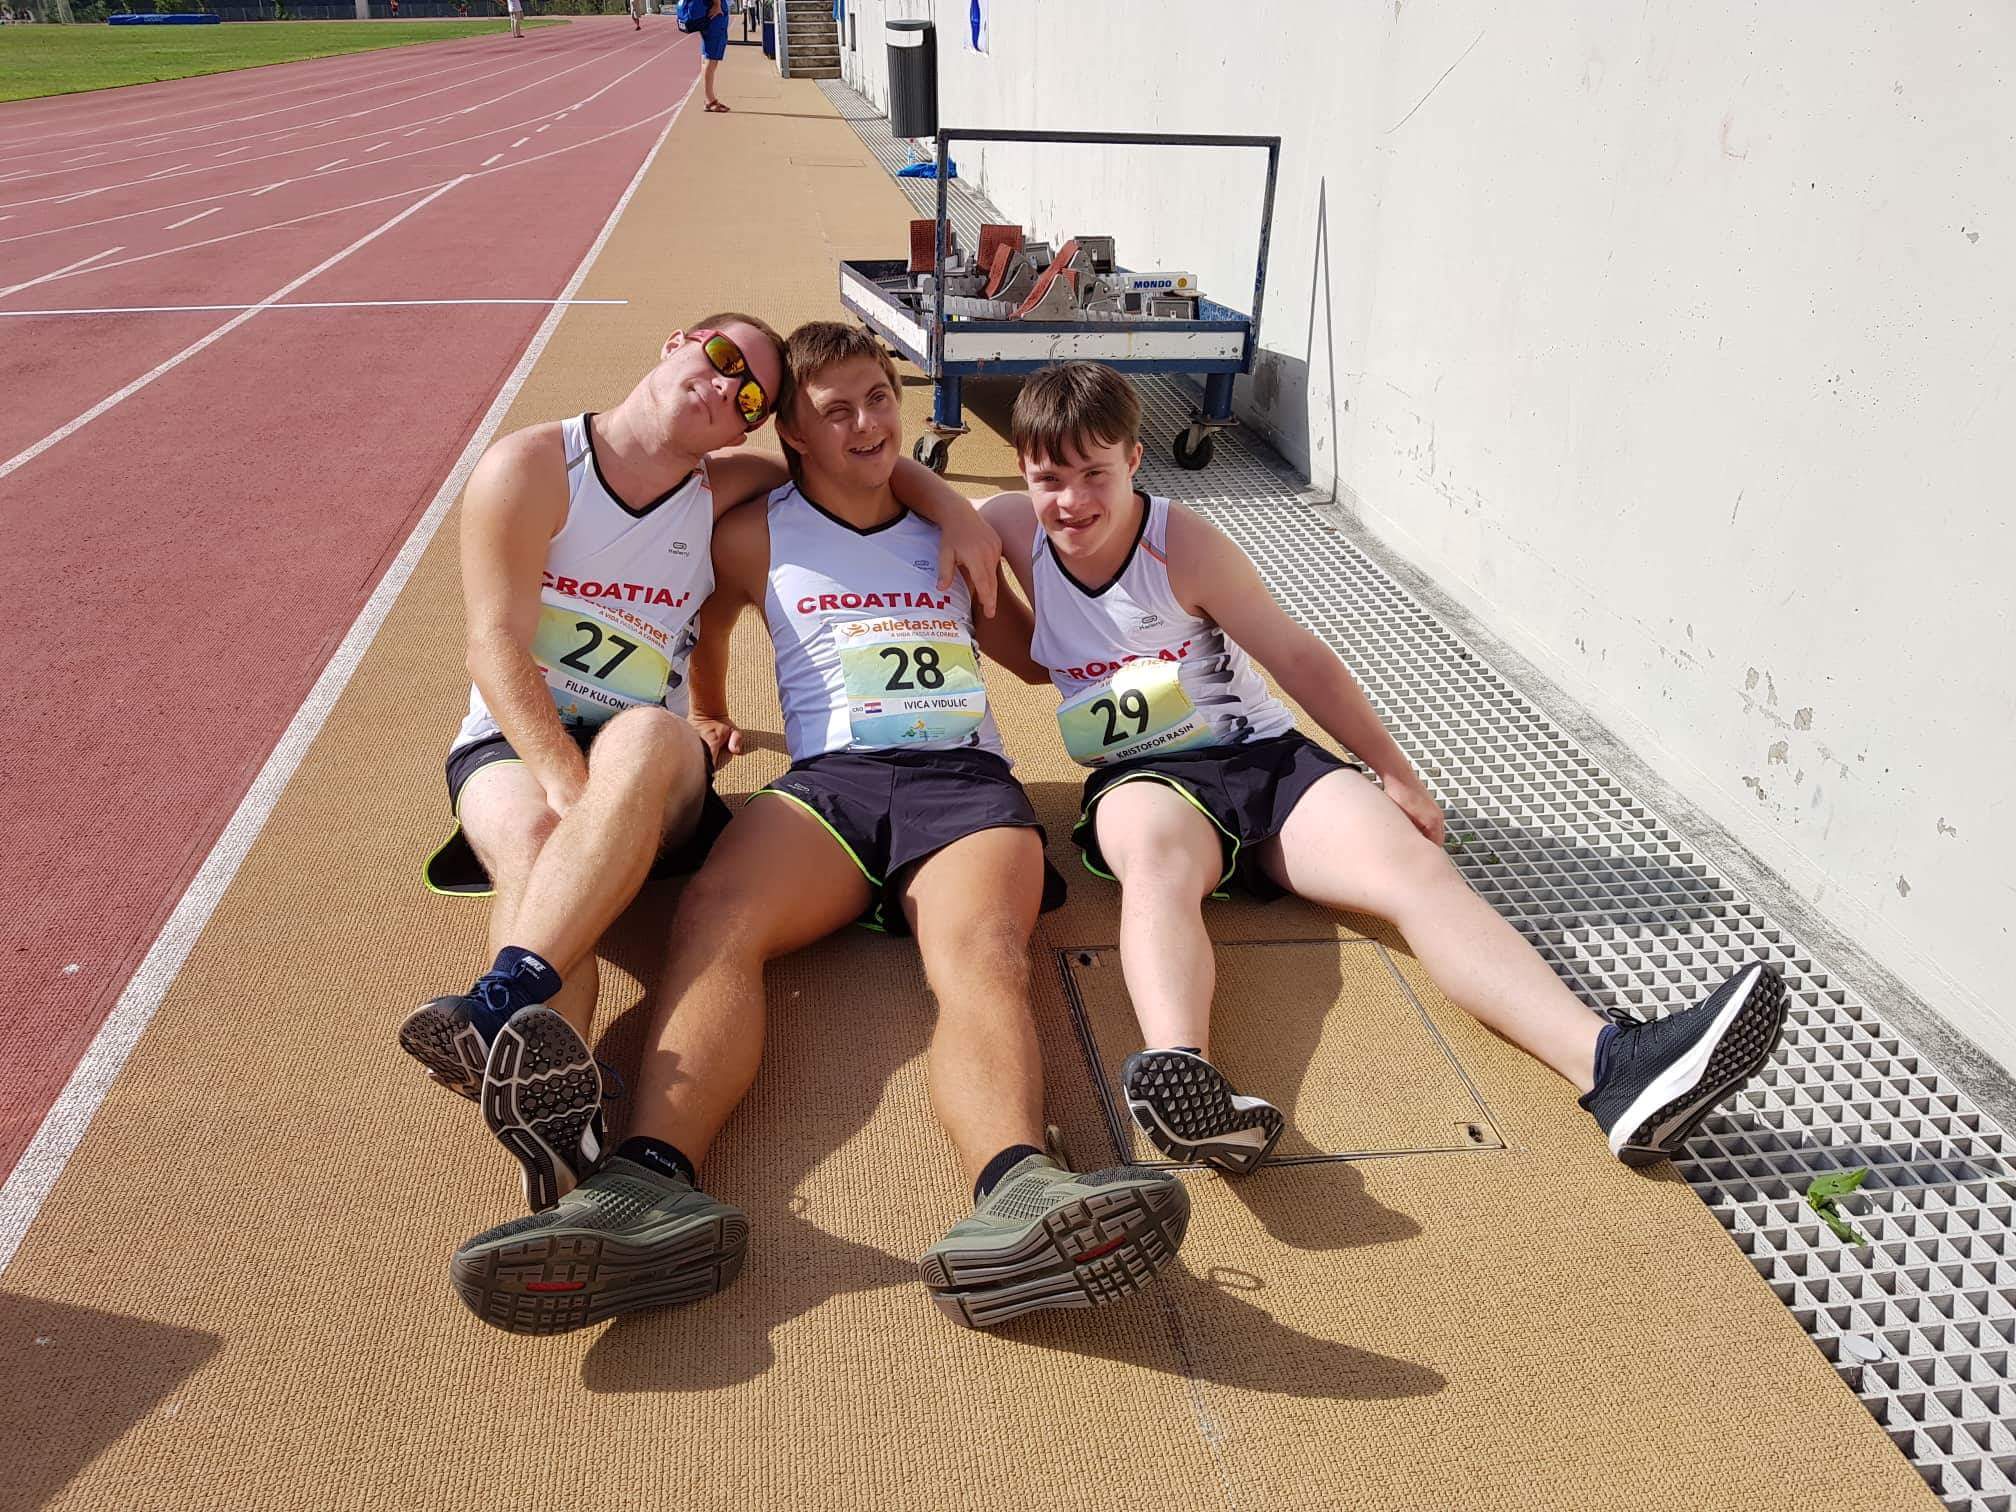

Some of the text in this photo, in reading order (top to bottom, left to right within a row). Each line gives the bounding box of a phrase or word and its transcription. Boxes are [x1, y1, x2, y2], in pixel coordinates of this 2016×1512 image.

[1133, 280, 1172, 289] MONDO
[797, 592, 934, 614] CROATIA
[872, 618, 959, 634] atletas.net
[560, 622, 639, 680] 27
[879, 646, 945, 691] 28
[565, 680, 589, 695] FILIP
[904, 698, 968, 710] IVICA VIDULIC
[1090, 688, 1149, 747] 29
[1116, 722, 1194, 760] KRISTOFOR RASIN
